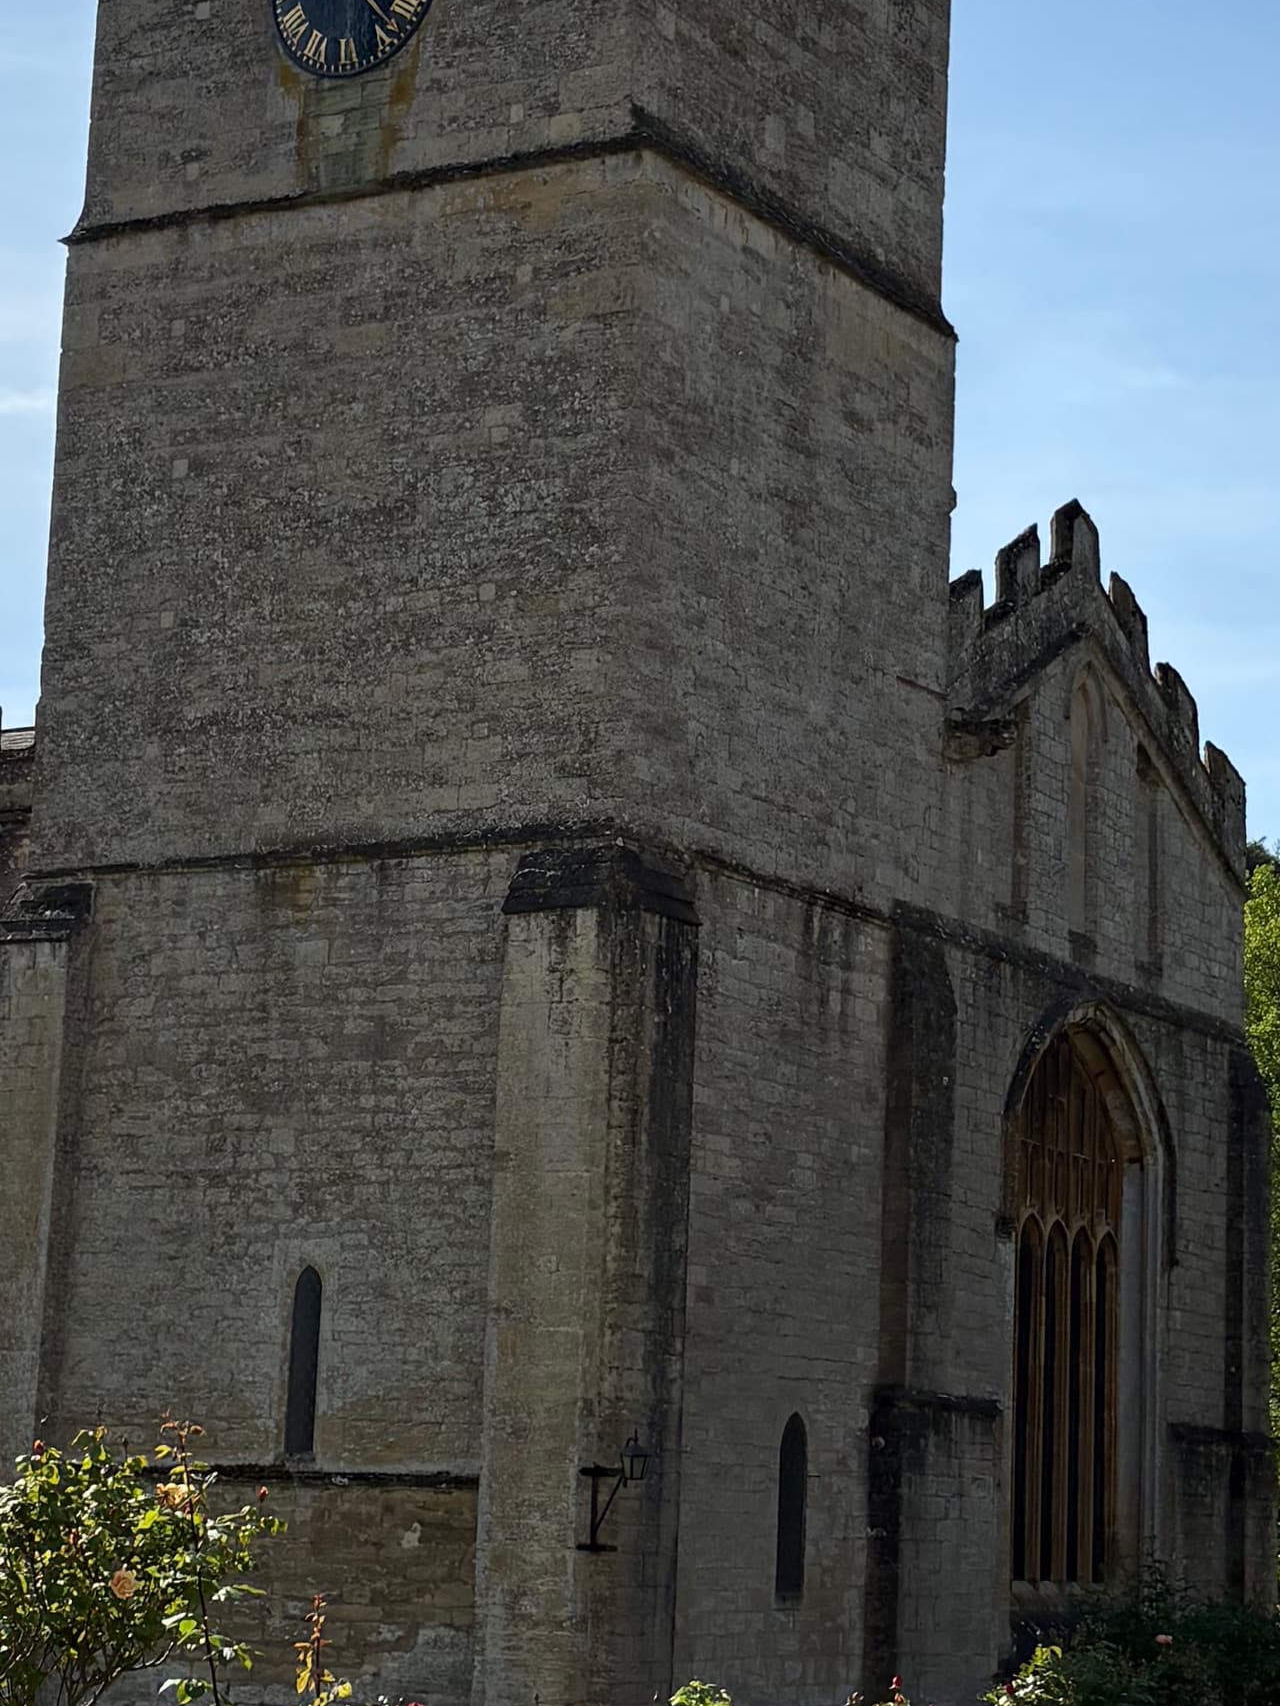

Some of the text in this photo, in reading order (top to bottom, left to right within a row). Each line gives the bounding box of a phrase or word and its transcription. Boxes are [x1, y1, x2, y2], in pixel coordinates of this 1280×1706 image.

[282, 2, 309, 49] VIII
[303, 29, 328, 64] VII
[338, 37, 359, 64] VI
